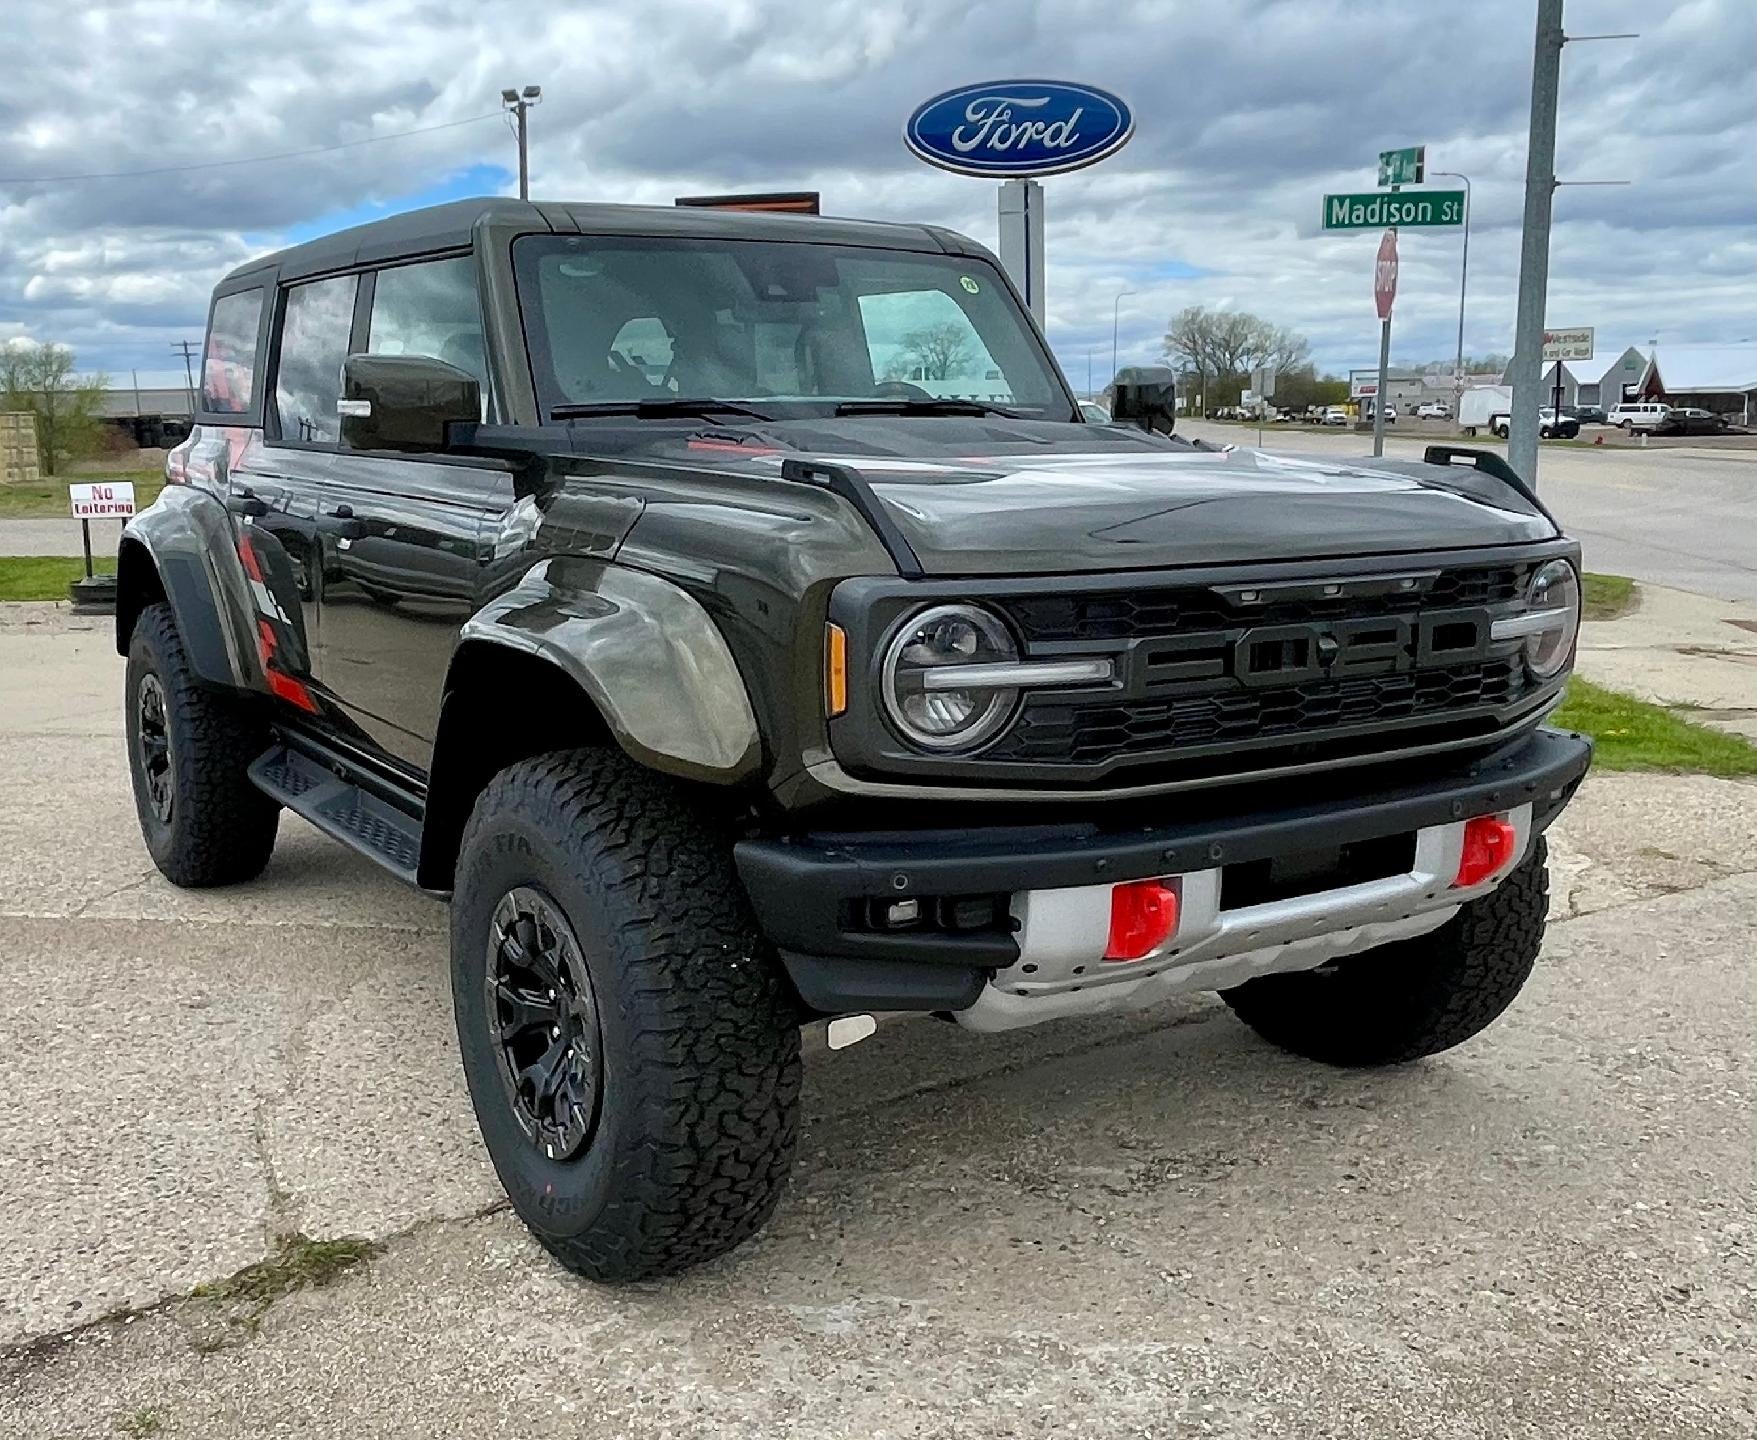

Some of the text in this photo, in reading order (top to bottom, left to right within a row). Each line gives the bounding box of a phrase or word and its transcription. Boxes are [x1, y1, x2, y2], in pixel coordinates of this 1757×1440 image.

[952, 96, 1083, 152] Ford
[1331, 197, 1459, 225] Madison St
[74, 485, 133, 514] No Loitering
[1128, 607, 1490, 699] FORD
